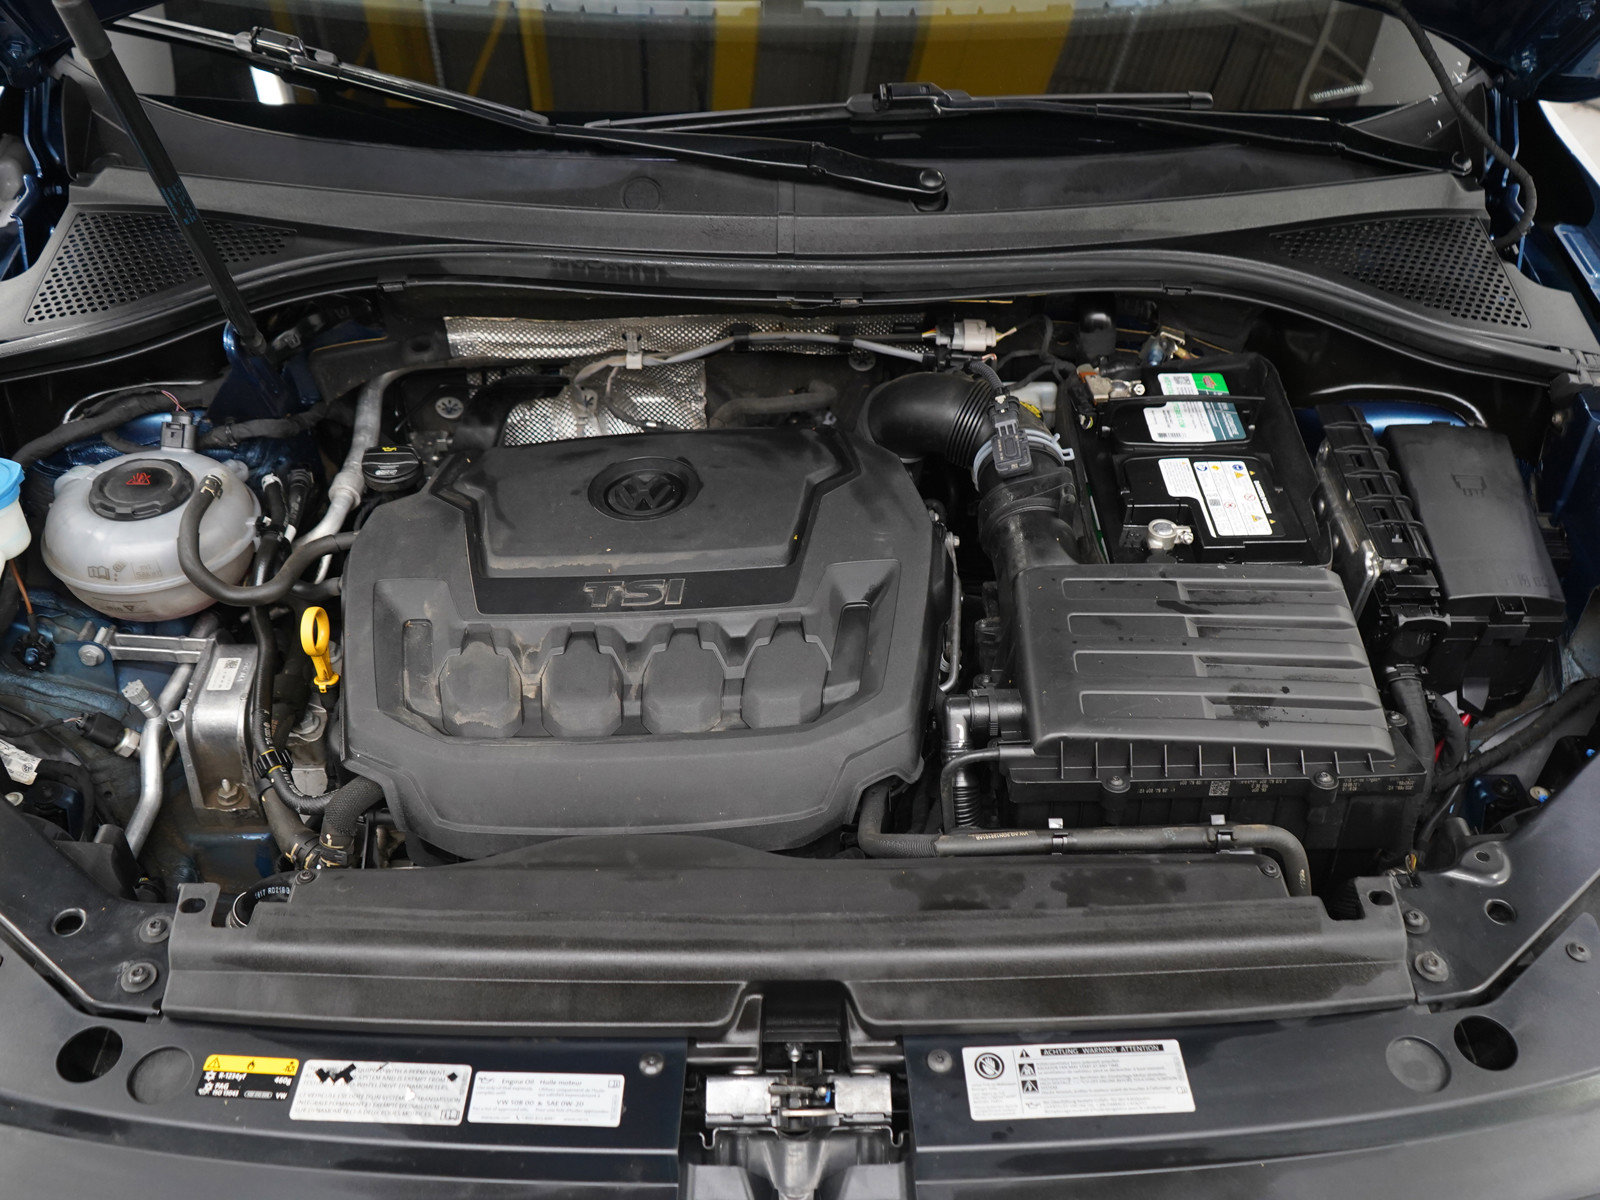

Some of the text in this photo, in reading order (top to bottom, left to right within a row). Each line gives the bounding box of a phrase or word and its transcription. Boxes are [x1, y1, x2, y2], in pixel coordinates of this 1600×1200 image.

[583, 578, 686, 608] TSI
[1083, 1046, 1117, 1054] WARNING
[1121, 1045, 1159, 1053] ATTENTION
[275, 1091, 288, 1100] VW
